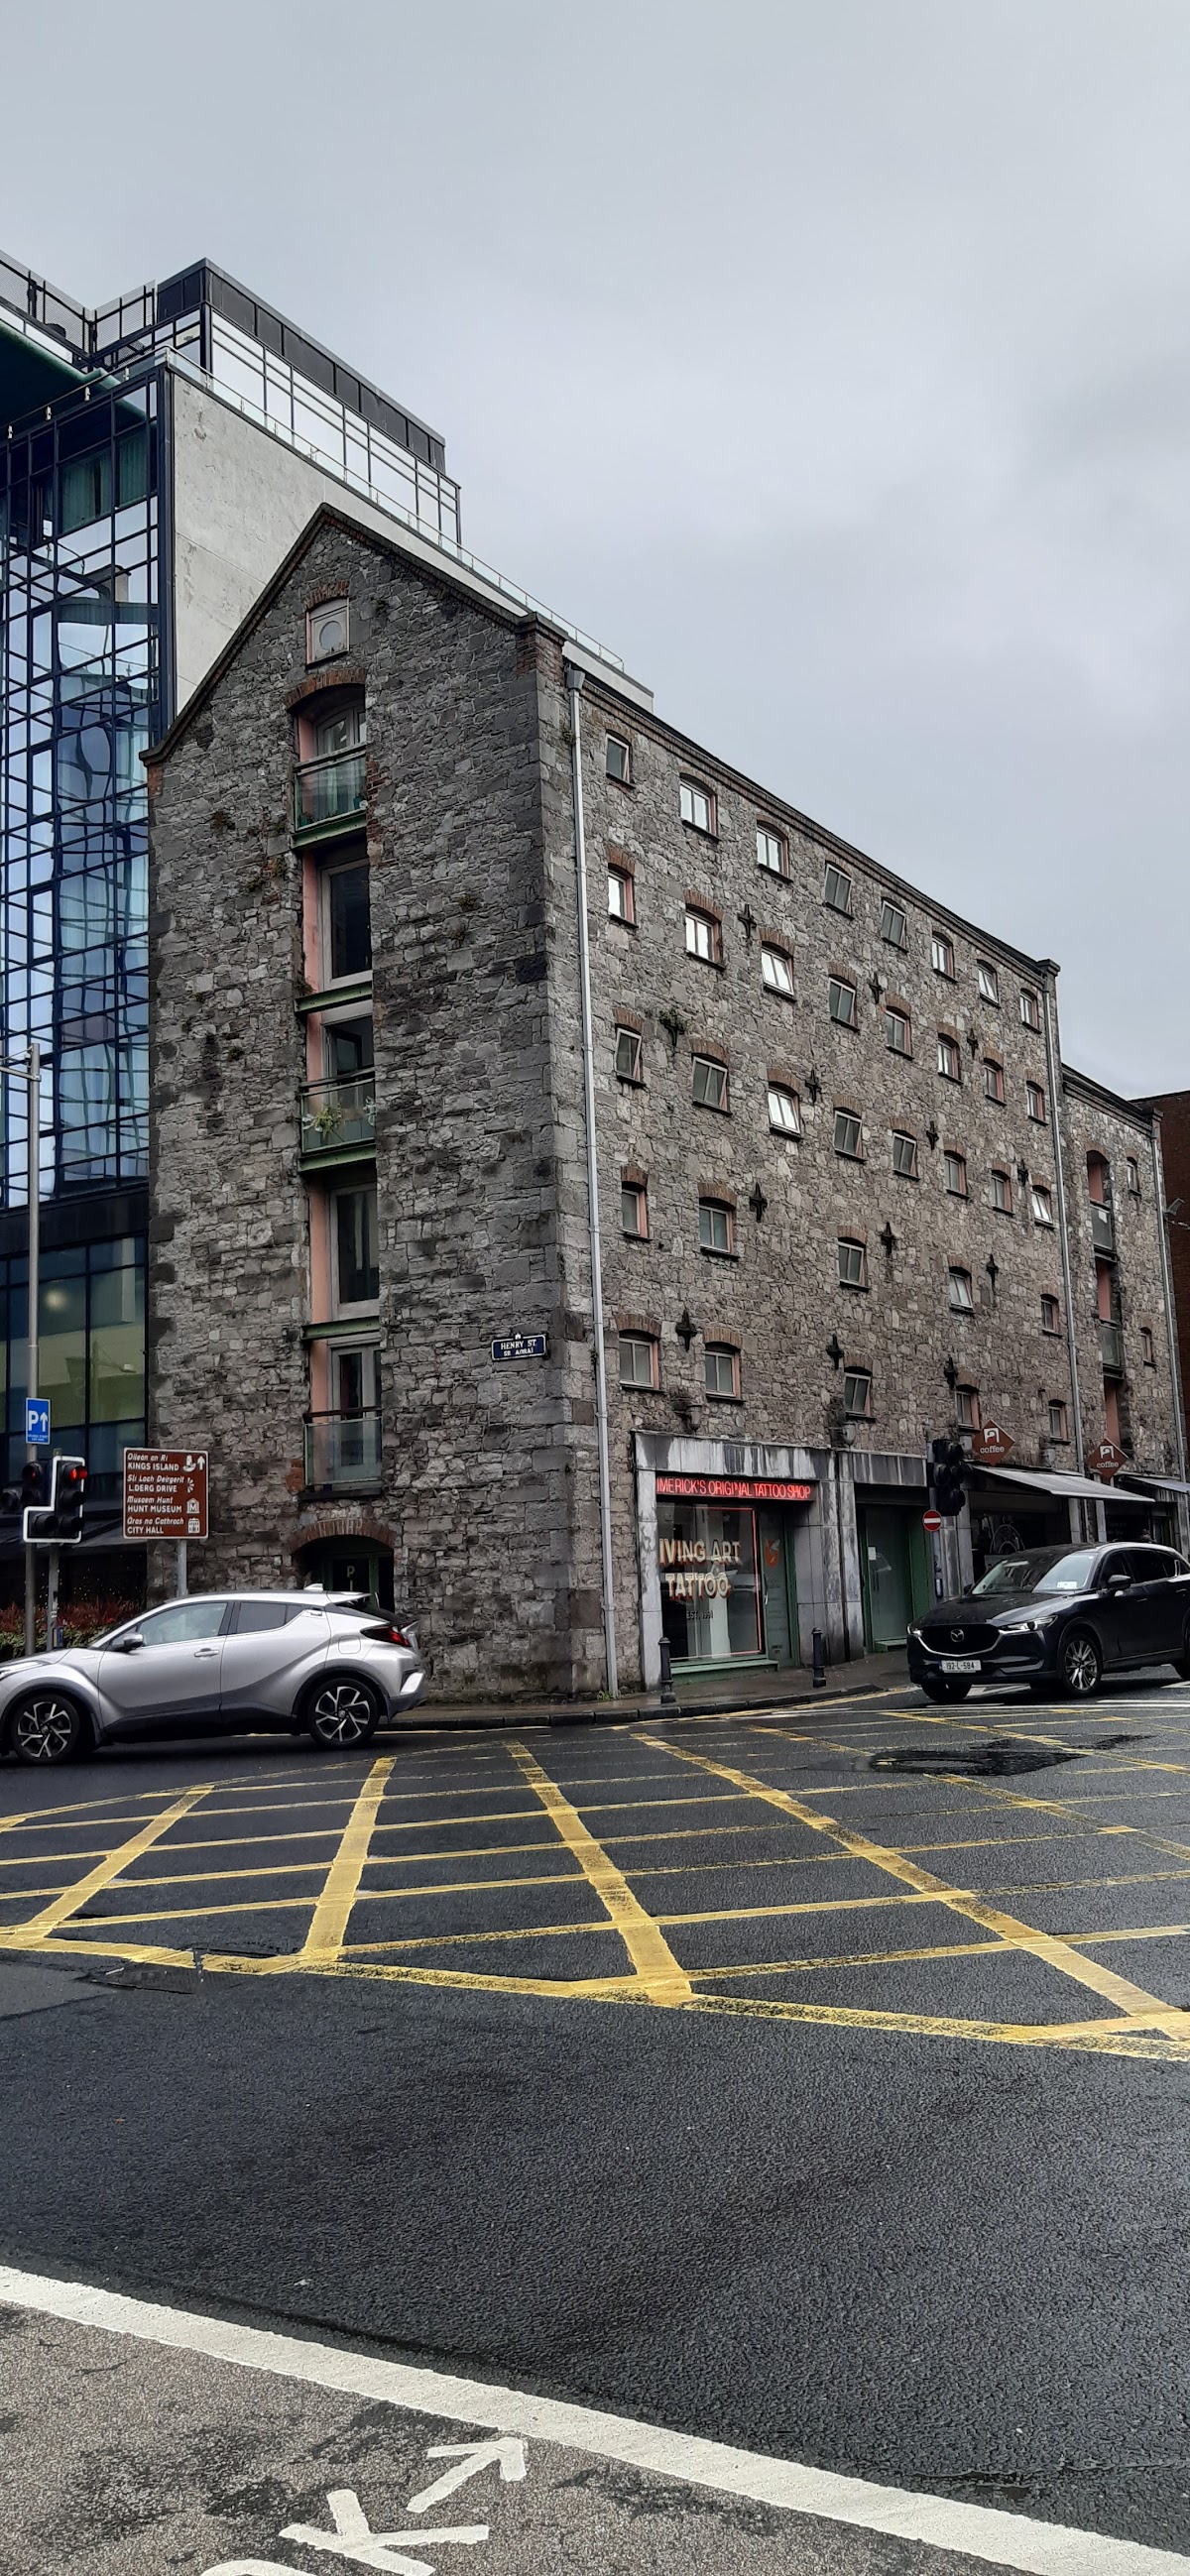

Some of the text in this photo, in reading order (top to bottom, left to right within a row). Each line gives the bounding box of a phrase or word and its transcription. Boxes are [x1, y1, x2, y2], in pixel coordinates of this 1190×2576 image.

[501, 1341, 524, 1349] HENRY
[28, 1410, 39, 1431] P
[980, 1445, 1005, 1455] coffee
[656, 1476, 811, 1499] IMERICK'S ORIGINAL TATTOO SHOP
[658, 1538, 742, 1565] IVING ART
[664, 1573, 731, 1599] TATTOO
